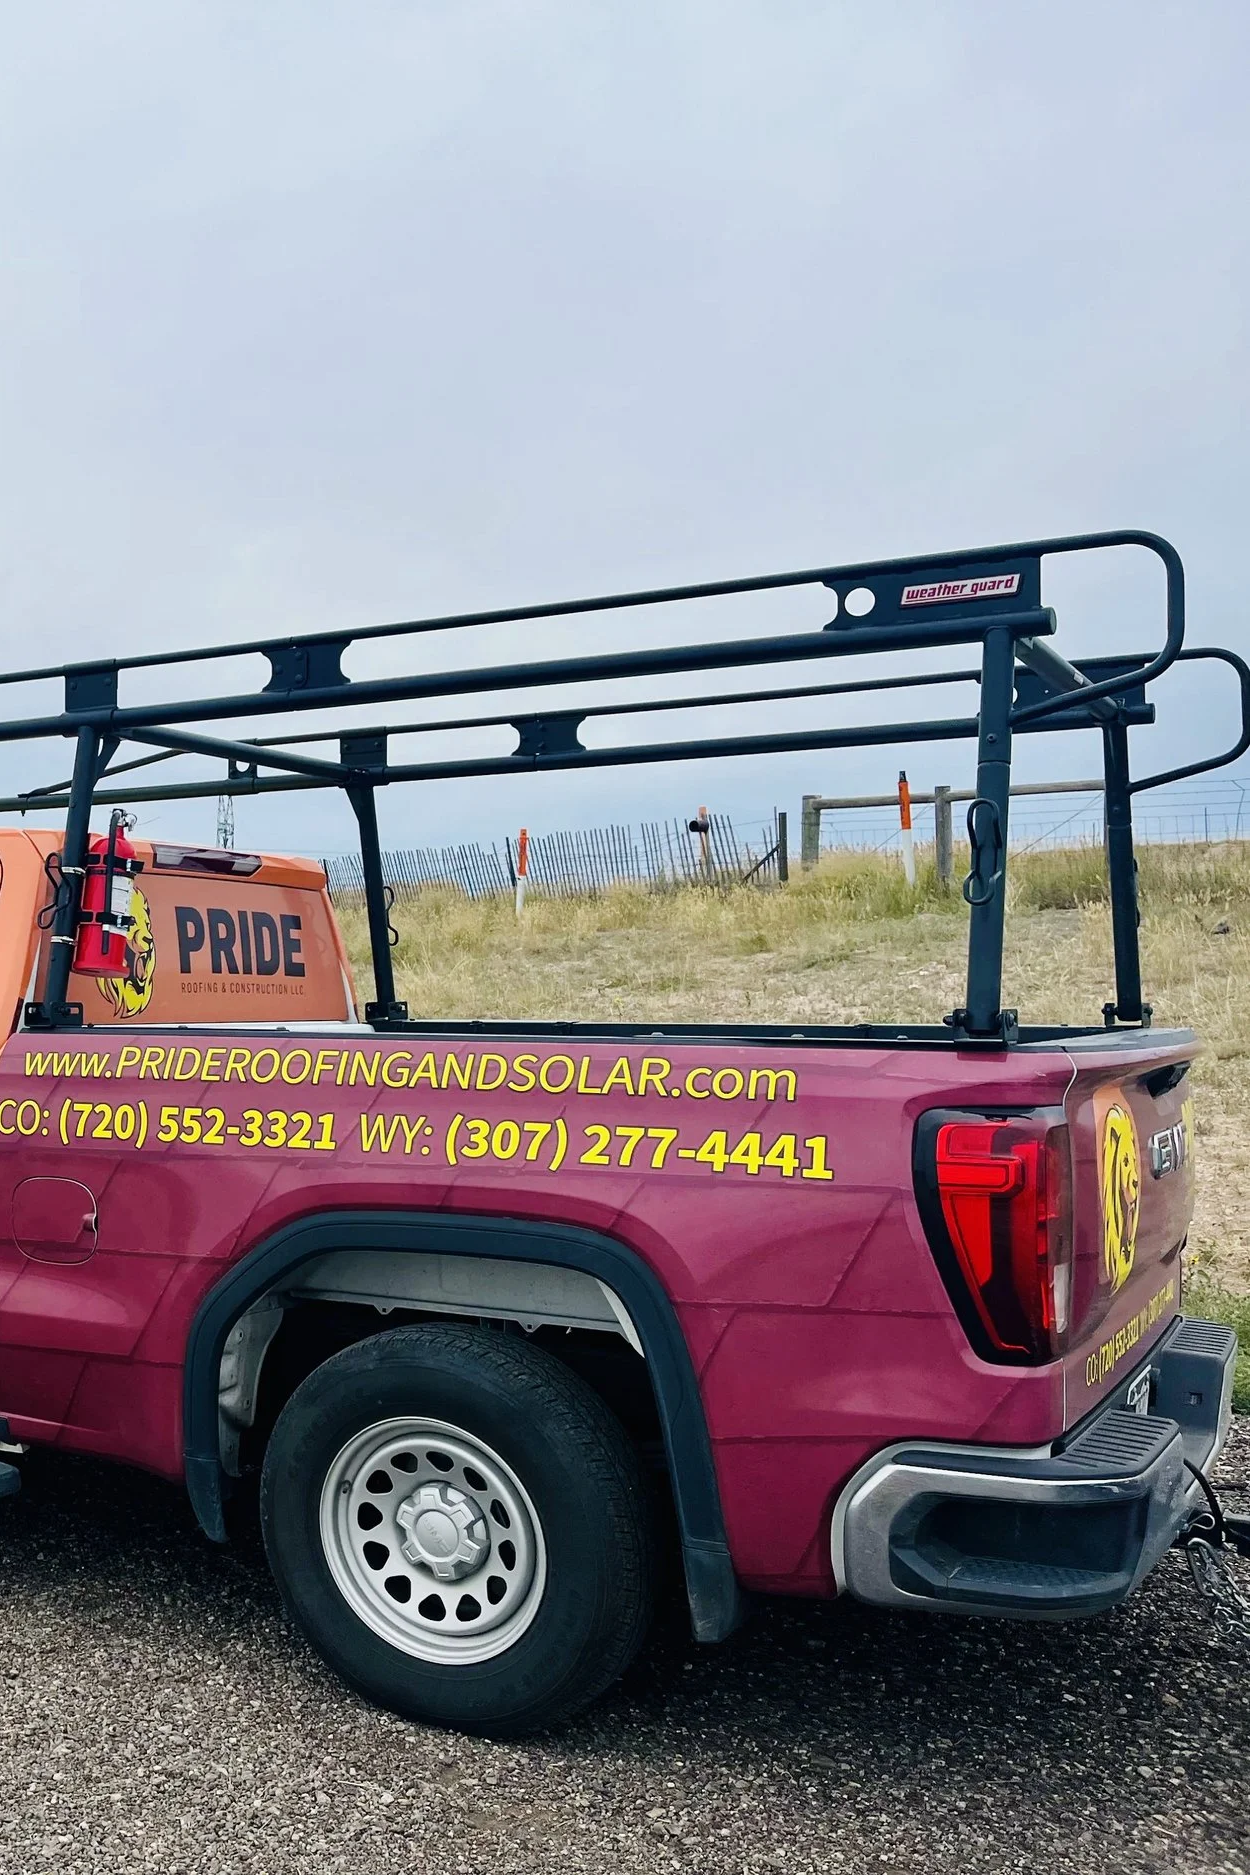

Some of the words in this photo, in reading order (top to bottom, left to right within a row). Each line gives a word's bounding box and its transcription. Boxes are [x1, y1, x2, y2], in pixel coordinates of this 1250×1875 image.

[905, 583, 968, 600] weather
[970, 575, 1015, 595] guard
[174, 905, 306, 978] PRIDE
[181, 982, 218, 994] ROOFING
[221, 982, 227, 993] &
[229, 982, 288, 995] CONSTRUCTION
[23, 1045, 798, 1102] www.PRIDEROOFINGANDSOLAR.com
[58, 1097, 149, 1150] (720)
[157, 1105, 337, 1151] 552-3321
[361, 1112, 432, 1155] WY:
[444, 1113, 569, 1171] (307)
[579, 1123, 835, 1181] 277-4441
